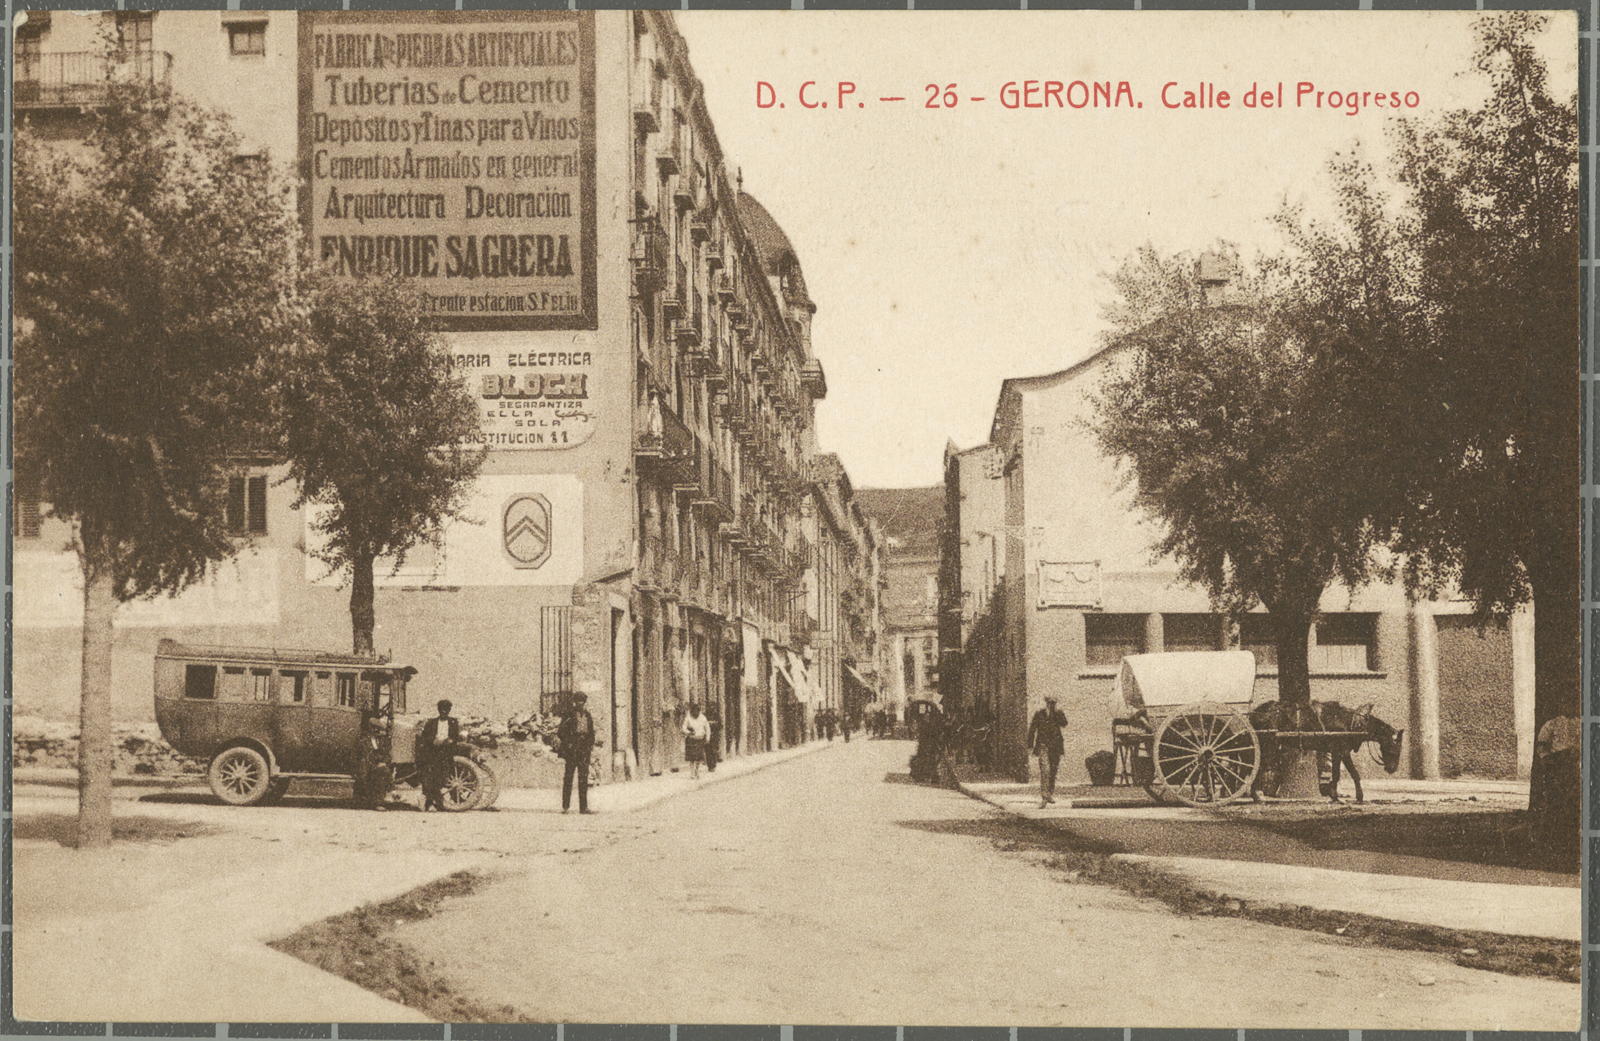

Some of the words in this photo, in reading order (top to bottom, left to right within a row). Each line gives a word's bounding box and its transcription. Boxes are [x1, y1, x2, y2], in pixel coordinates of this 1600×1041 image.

[396, 33, 464, 67] PIEDRAS
[466, 31, 578, 67] ARTIFICIALES
[459, 74, 570, 104] Cemento
[411, 121, 422, 144] y
[420, 111, 475, 142] Tinas
[477, 116, 523, 146] para
[522, 110, 580, 141] Vinos
[314, 149, 400, 180] Cementos
[400, 148, 481, 180] Armados
[486, 154, 507, 179] en
[511, 150, 579, 181] general
[323, 186, 446, 224] Arquitectura
[445, 234, 575, 281] SAGRERA
[507, 350, 592, 367] ELÉCTRICA
[481, 373, 588, 400] BLOCH
[487, 410, 533, 418] ELLA
[514, 419, 561, 427] SOLA
[461, 432, 544, 445] ONSTITUCION
